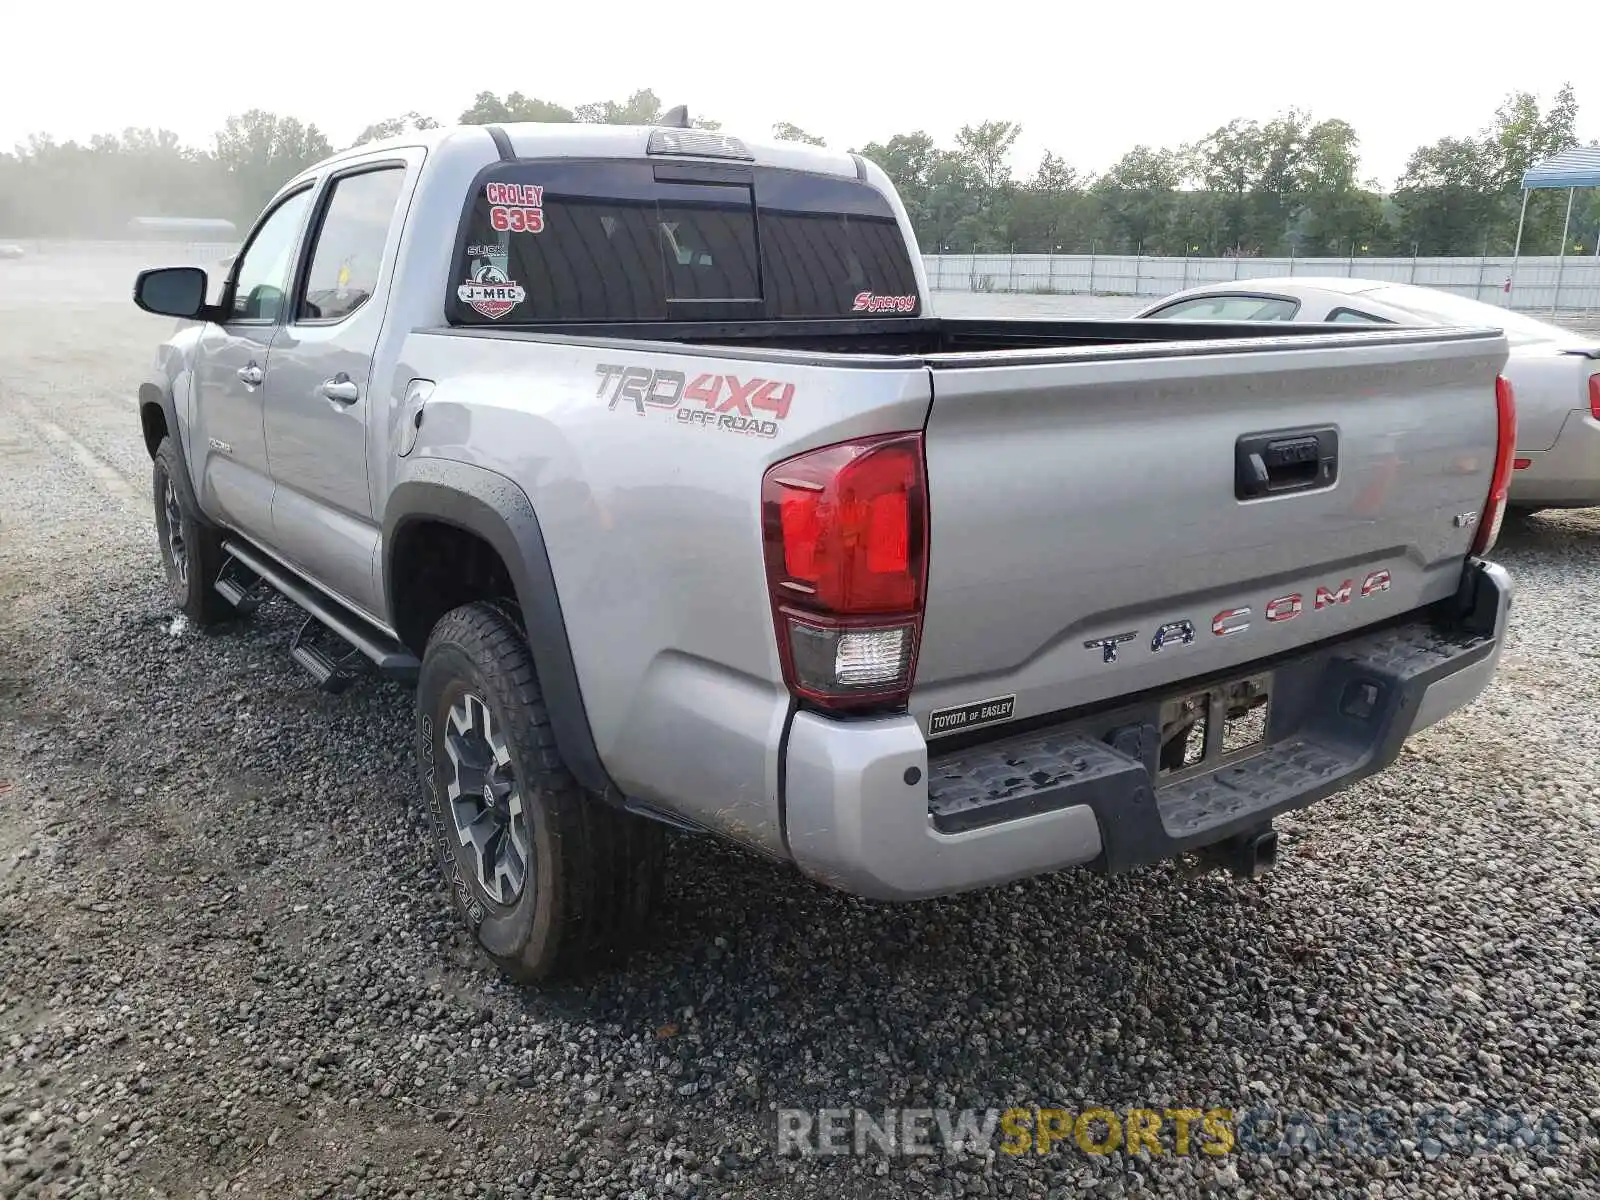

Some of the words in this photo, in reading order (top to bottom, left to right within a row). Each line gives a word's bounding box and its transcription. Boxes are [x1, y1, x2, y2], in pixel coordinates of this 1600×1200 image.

[486, 182, 544, 207] CROLEY
[490, 206, 544, 233] 635
[466, 288, 516, 299] J-MAC
[852, 291, 916, 313] Synergy
[595, 363, 687, 416] TRD
[676, 408, 717, 427] OFF
[717, 414, 780, 439] ROAD
[1083, 567, 1393, 664] TACOMA
[934, 712, 966, 729] TOYOTA
[969, 712, 978, 721] OF
[981, 702, 1012, 718] EASLEY
